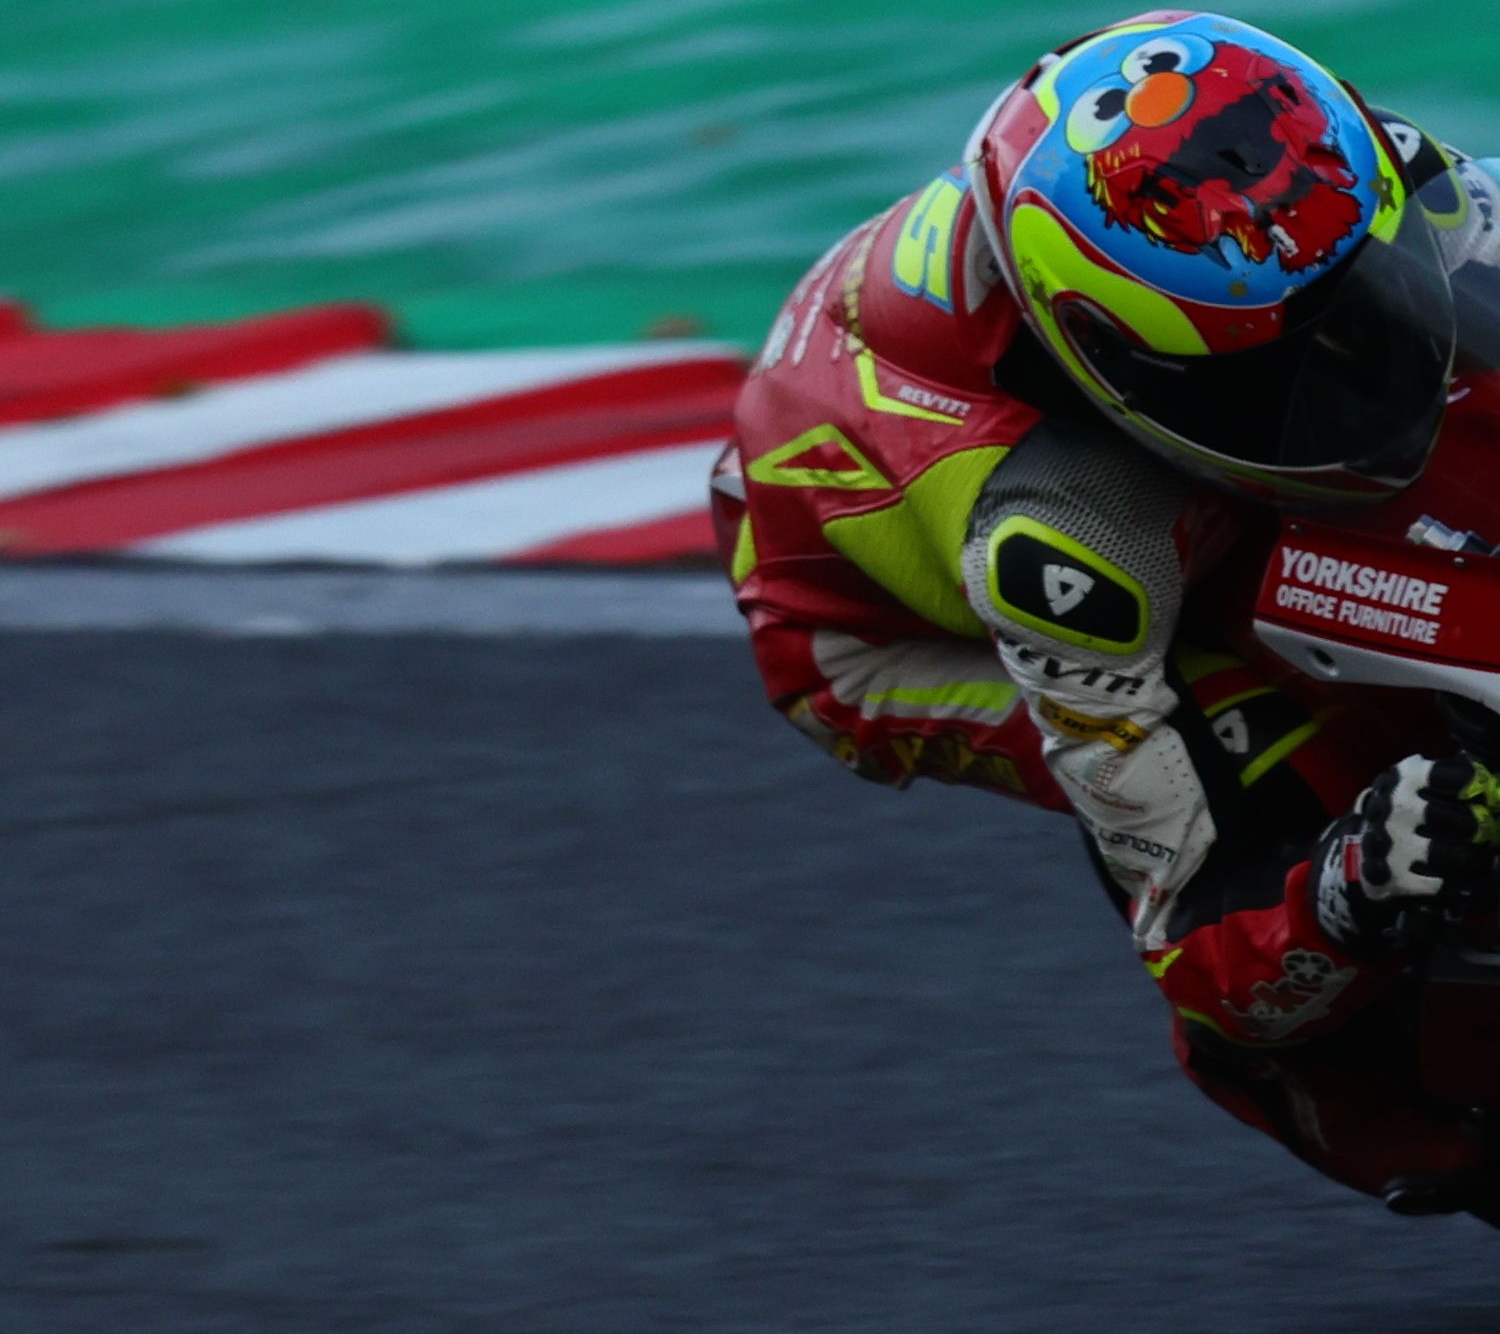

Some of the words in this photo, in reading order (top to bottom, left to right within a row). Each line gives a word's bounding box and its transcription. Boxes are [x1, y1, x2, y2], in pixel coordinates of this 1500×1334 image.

[1274, 583, 1340, 620] OFFICE
[1337, 599, 1442, 646] FURNITURE
[1279, 545, 1450, 617] YORKSHIRE
